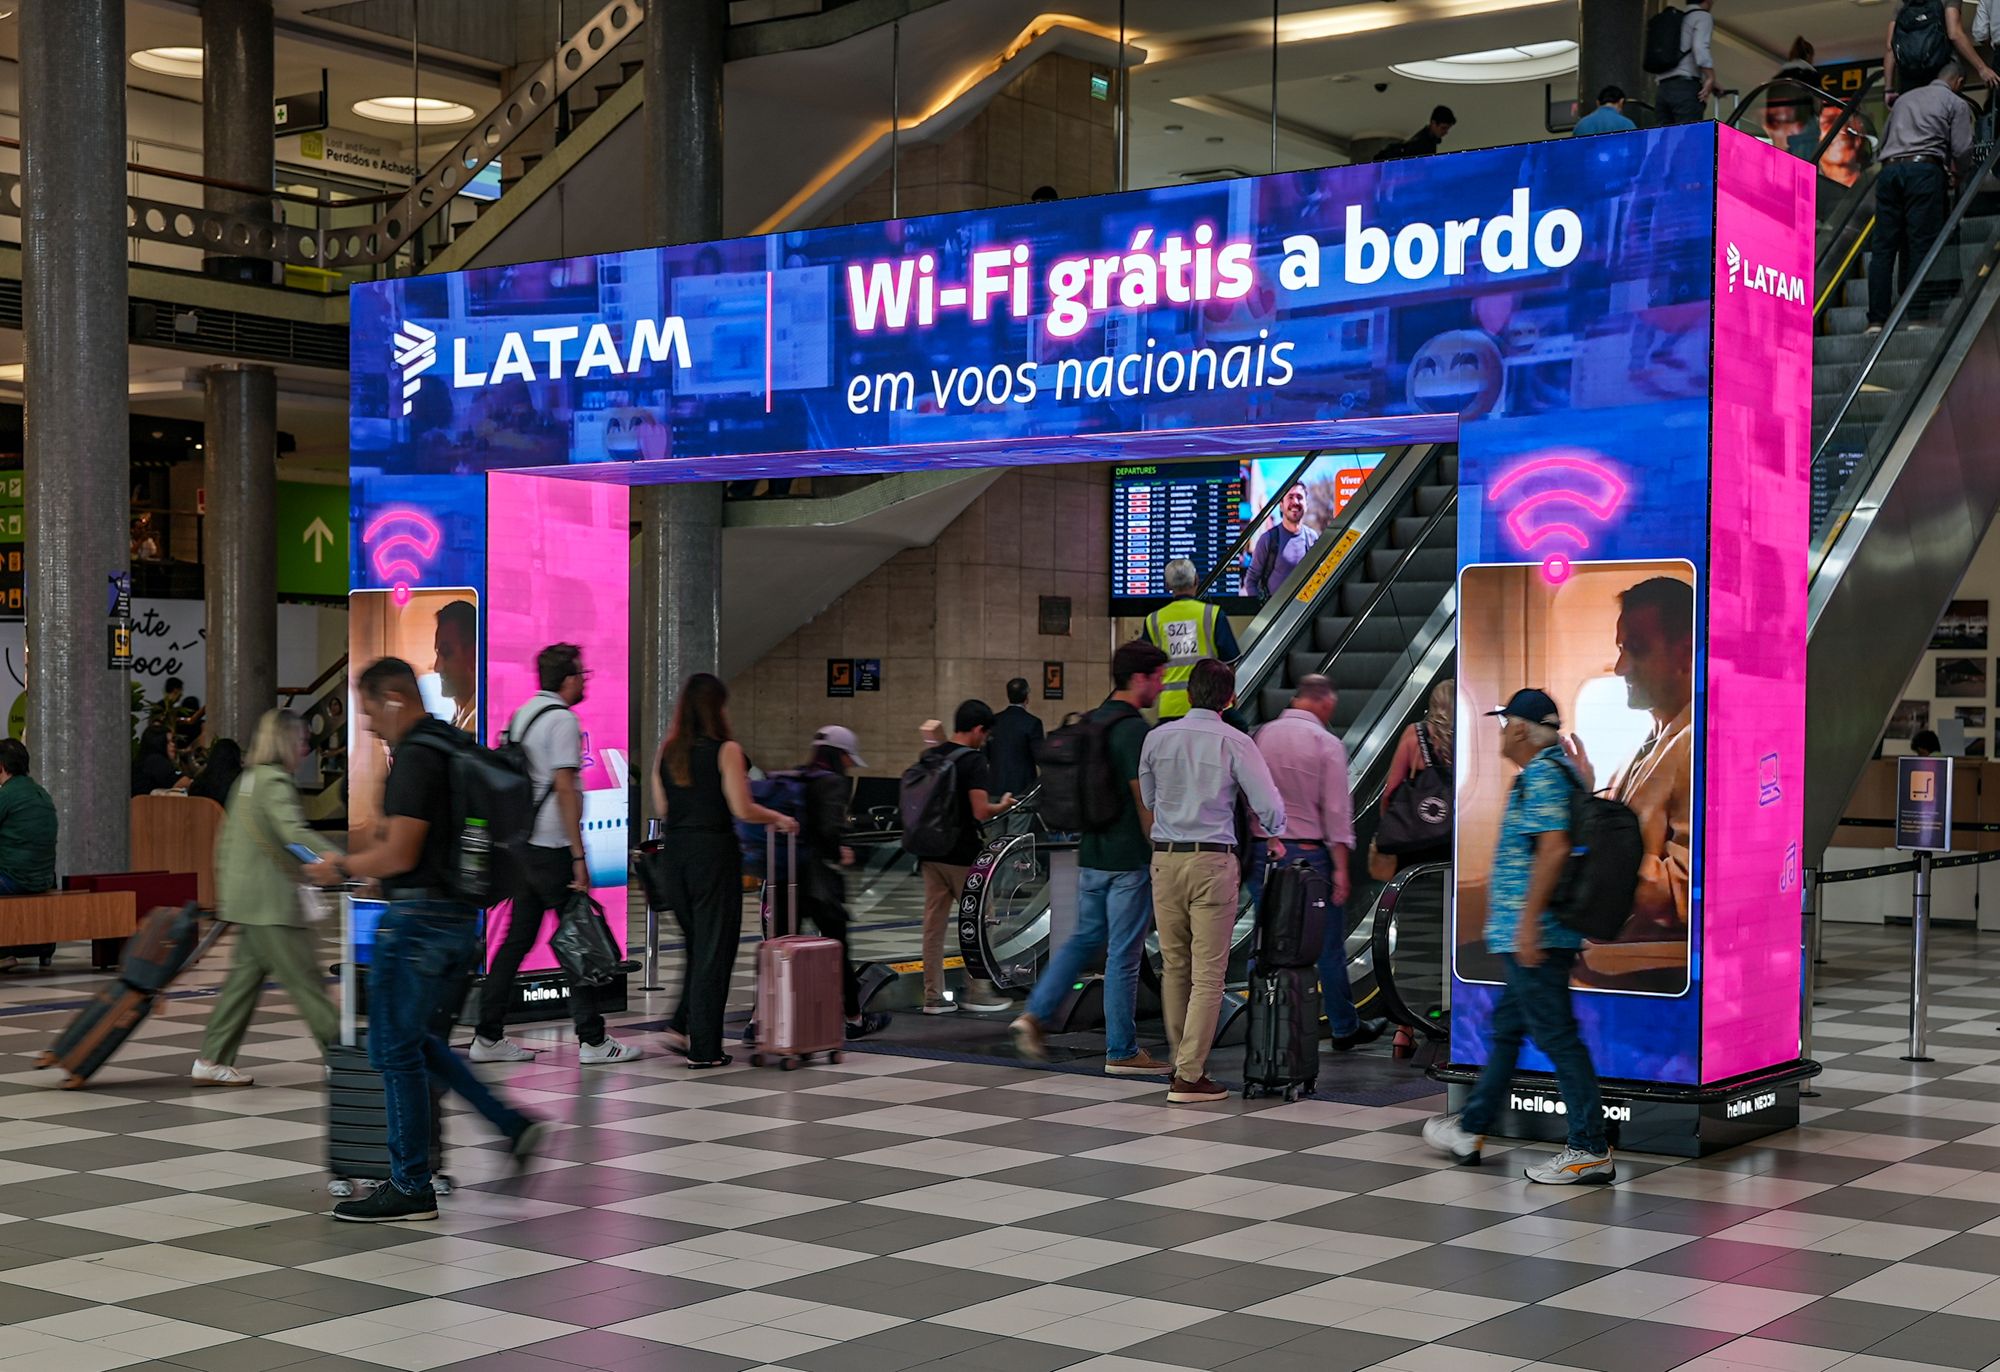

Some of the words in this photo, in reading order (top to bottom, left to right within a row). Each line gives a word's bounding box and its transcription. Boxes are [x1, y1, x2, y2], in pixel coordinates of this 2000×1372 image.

[326, 149, 370, 167] Perdidos
[372, 160, 379, 169] e
[848, 244, 1029, 331] Wi-Fi
[1046, 224, 1254, 338] grátis
[1279, 235, 1320, 291] a
[1345, 187, 1582, 284] bordo
[1743, 258, 1806, 306] LATAM
[453, 316, 692, 389] LATAM
[847, 371, 915, 414] em
[931, 362, 1038, 409] voos
[1054, 328, 1295, 402] nacionais
[1115, 466, 1157, 476] DEPARTURES
[1168, 622, 1191, 637] SZL
[1169, 640, 1198, 656] 0002
